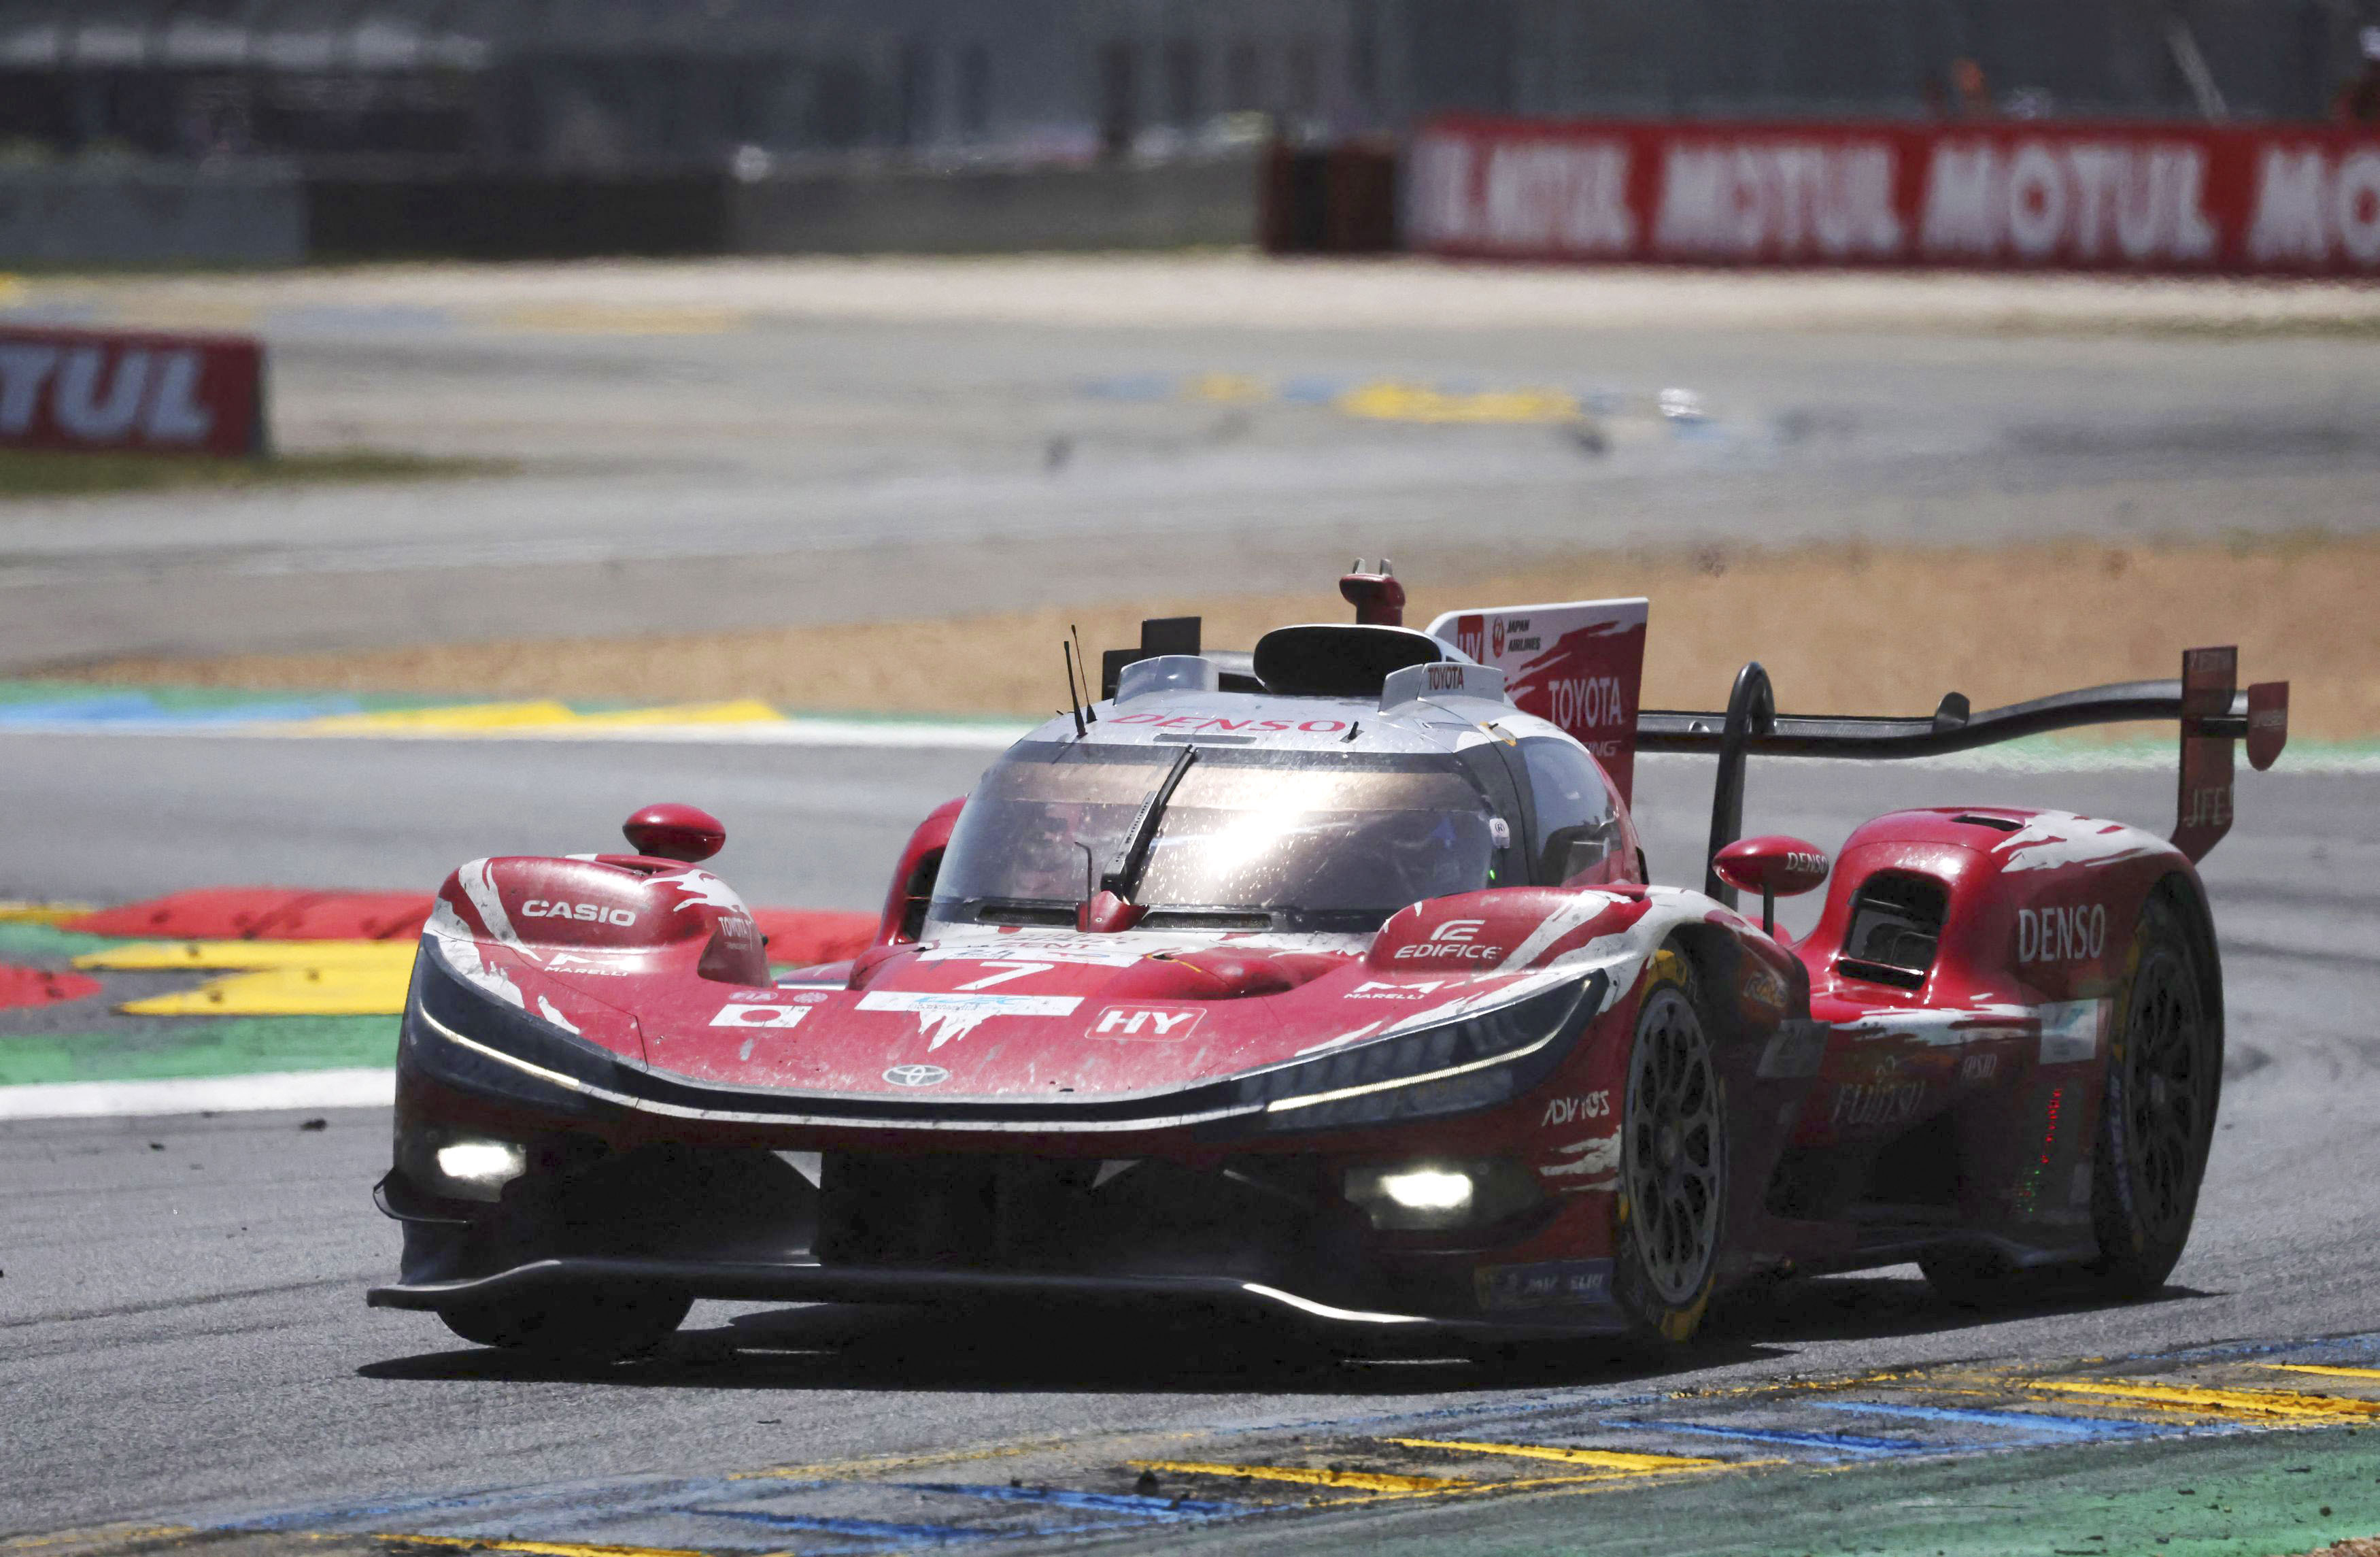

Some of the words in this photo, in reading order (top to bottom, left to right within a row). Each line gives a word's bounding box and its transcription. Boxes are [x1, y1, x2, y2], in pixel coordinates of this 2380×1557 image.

[1656, 143, 1901, 250] MOTUL
[1920, 144, 2215, 256] MOTUL
[1507, 619, 1530, 634] JAPAN
[1508, 637, 1541, 653] AIRLINES
[1428, 666, 1464, 690] TOYOTA
[1548, 677, 1623, 731] TOYOTA
[1108, 714, 1346, 732] DENSO
[1785, 852, 1829, 874] DENSO
[522, 899, 636, 927] CASIO
[2018, 903, 2106, 963] DENSO
[1395, 943, 1503, 959] EDIFICE
[544, 966, 628, 977] MARELLI
[953, 961, 1055, 991] 7
[1095, 1010, 1195, 1035] HY
